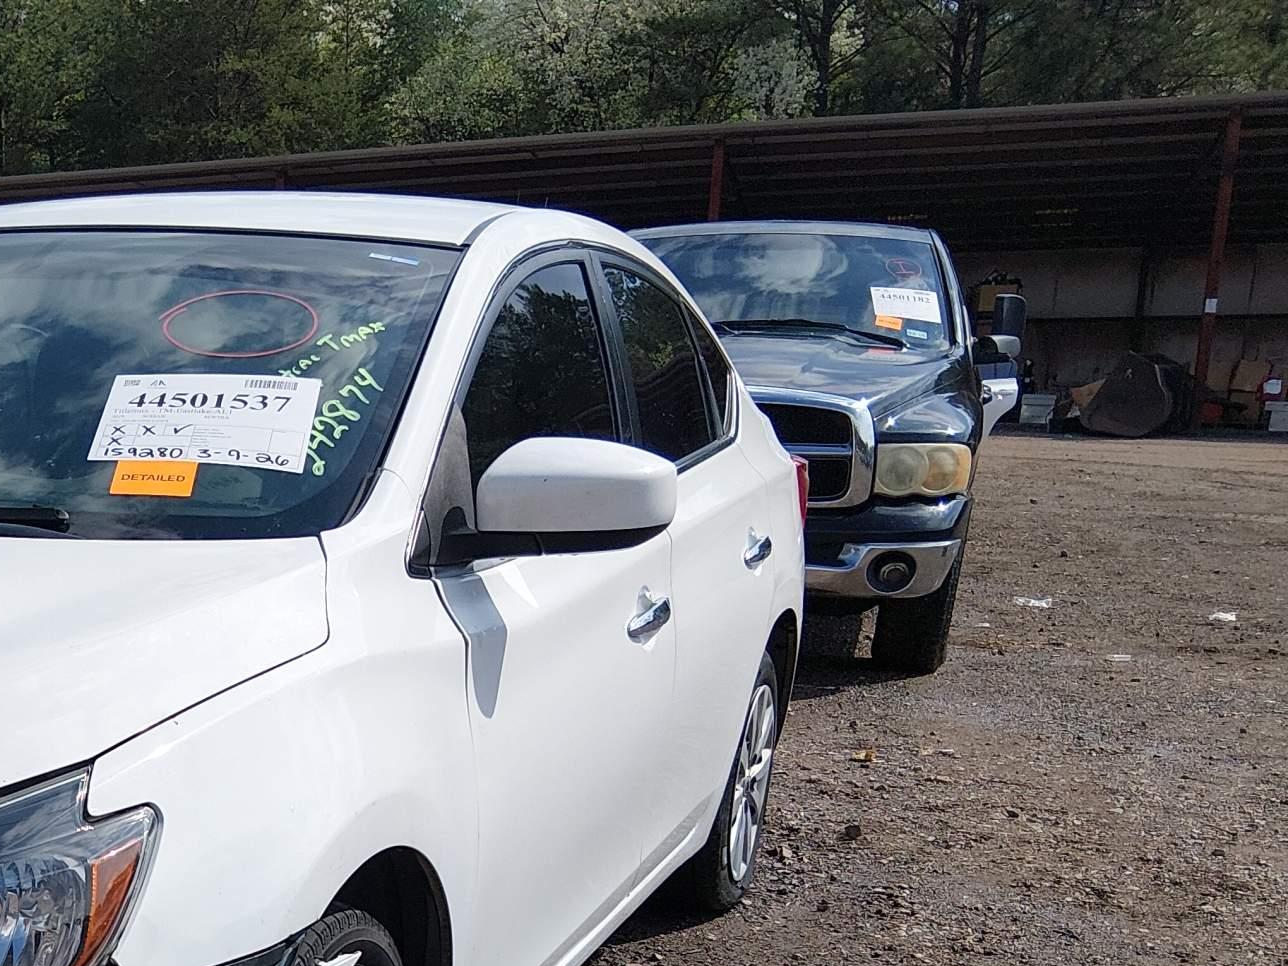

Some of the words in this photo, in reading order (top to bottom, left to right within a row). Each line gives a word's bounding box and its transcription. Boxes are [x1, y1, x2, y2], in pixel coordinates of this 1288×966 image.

[128, 392, 293, 412] 44501537
[103, 446, 184, 459] 159280
[120, 473, 186, 483] DETAILED
